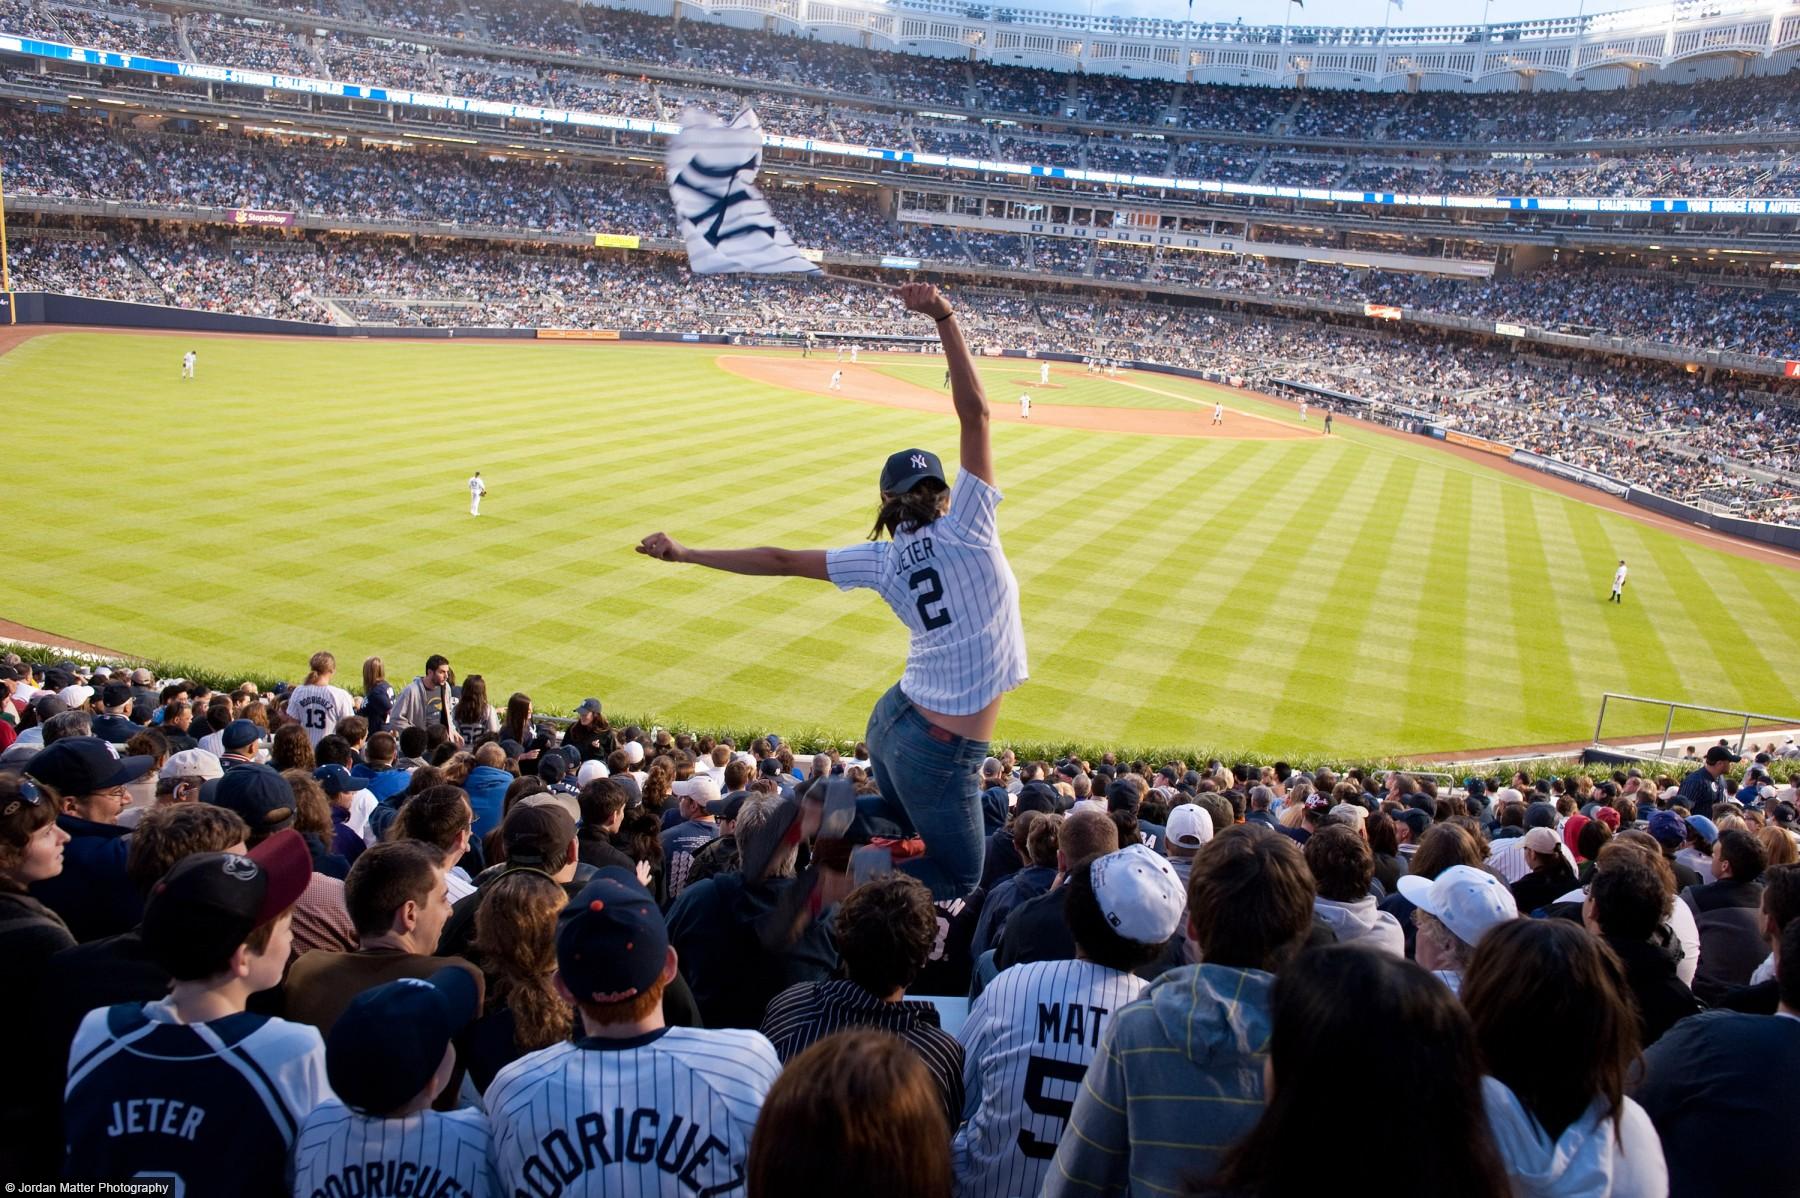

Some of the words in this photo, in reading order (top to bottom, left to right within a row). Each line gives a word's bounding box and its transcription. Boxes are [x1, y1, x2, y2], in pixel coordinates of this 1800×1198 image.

[896, 537, 936, 576] JETER
[908, 566, 952, 631] 2
[305, 708, 327, 730] 13
[107, 1098, 206, 1141] JETER
